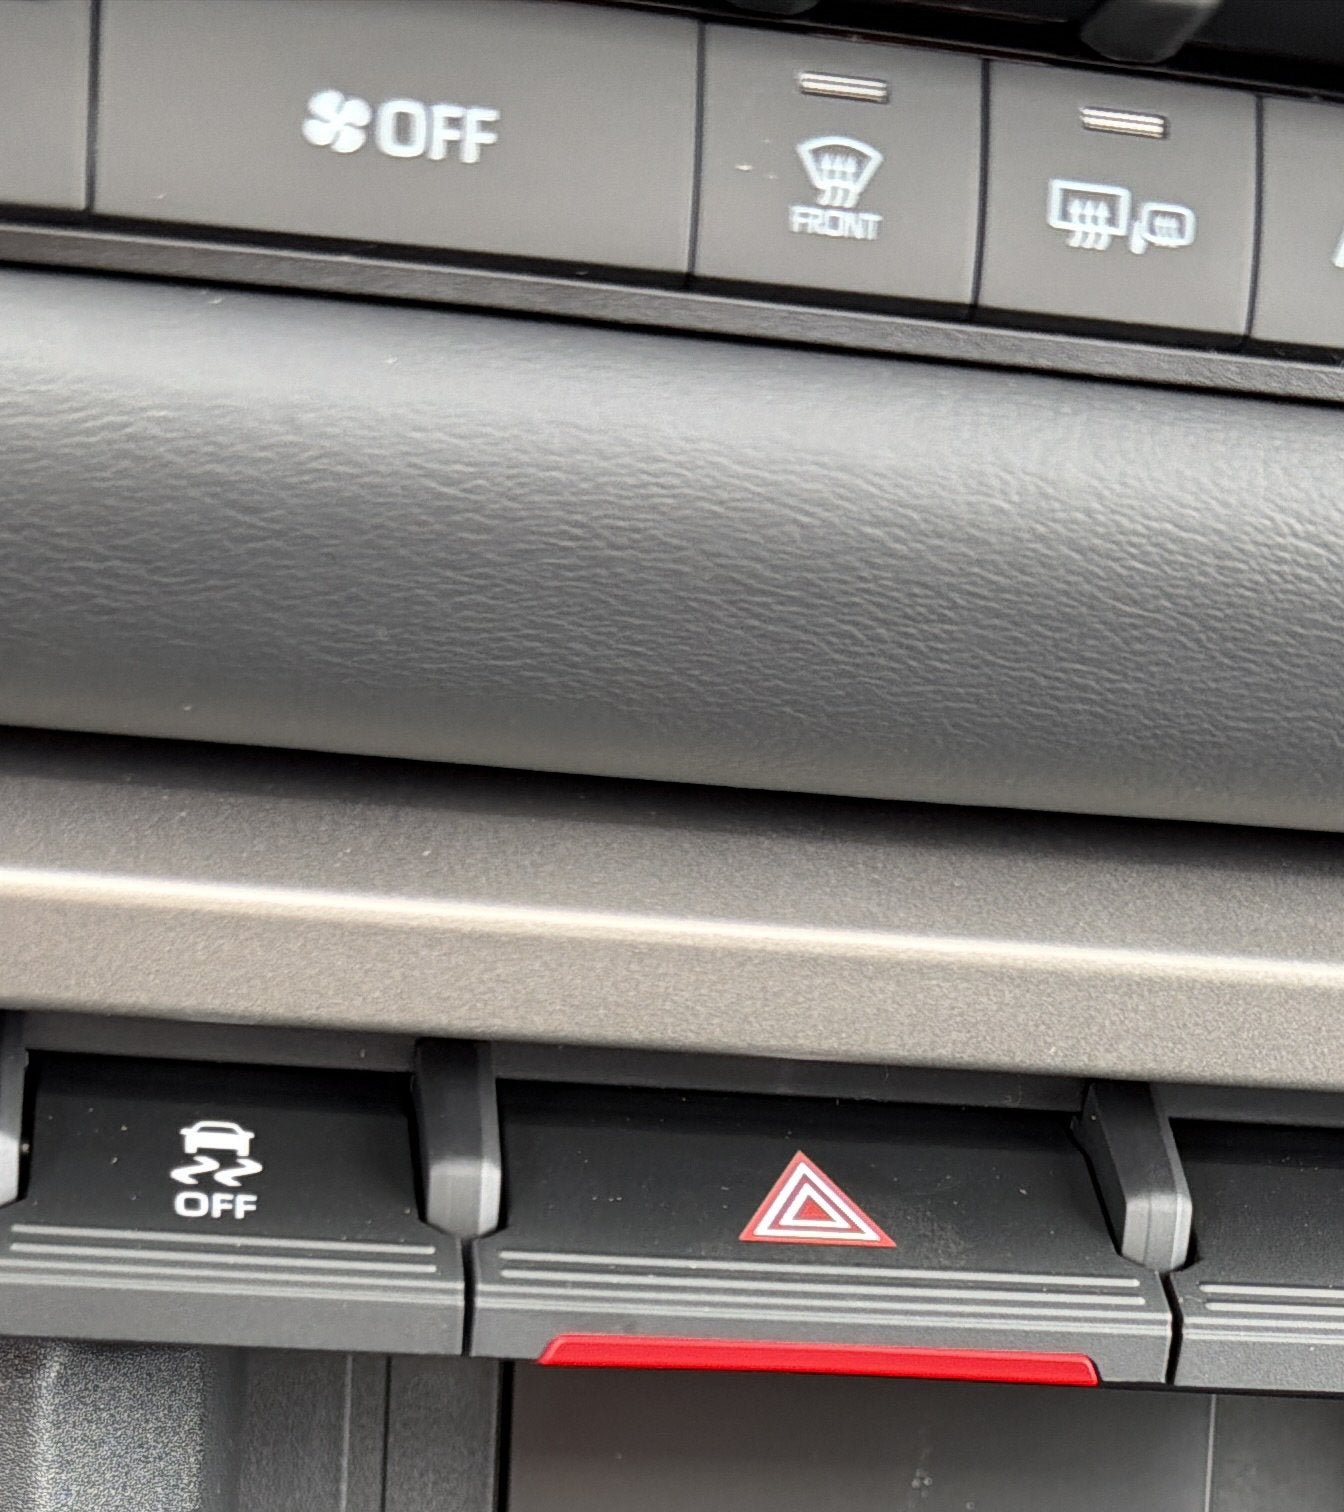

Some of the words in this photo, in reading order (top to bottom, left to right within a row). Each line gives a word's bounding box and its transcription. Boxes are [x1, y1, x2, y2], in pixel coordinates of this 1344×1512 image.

[375, 98, 498, 166] OFF
[790, 204, 882, 242] FRONT
[172, 1190, 260, 1221] OFF
